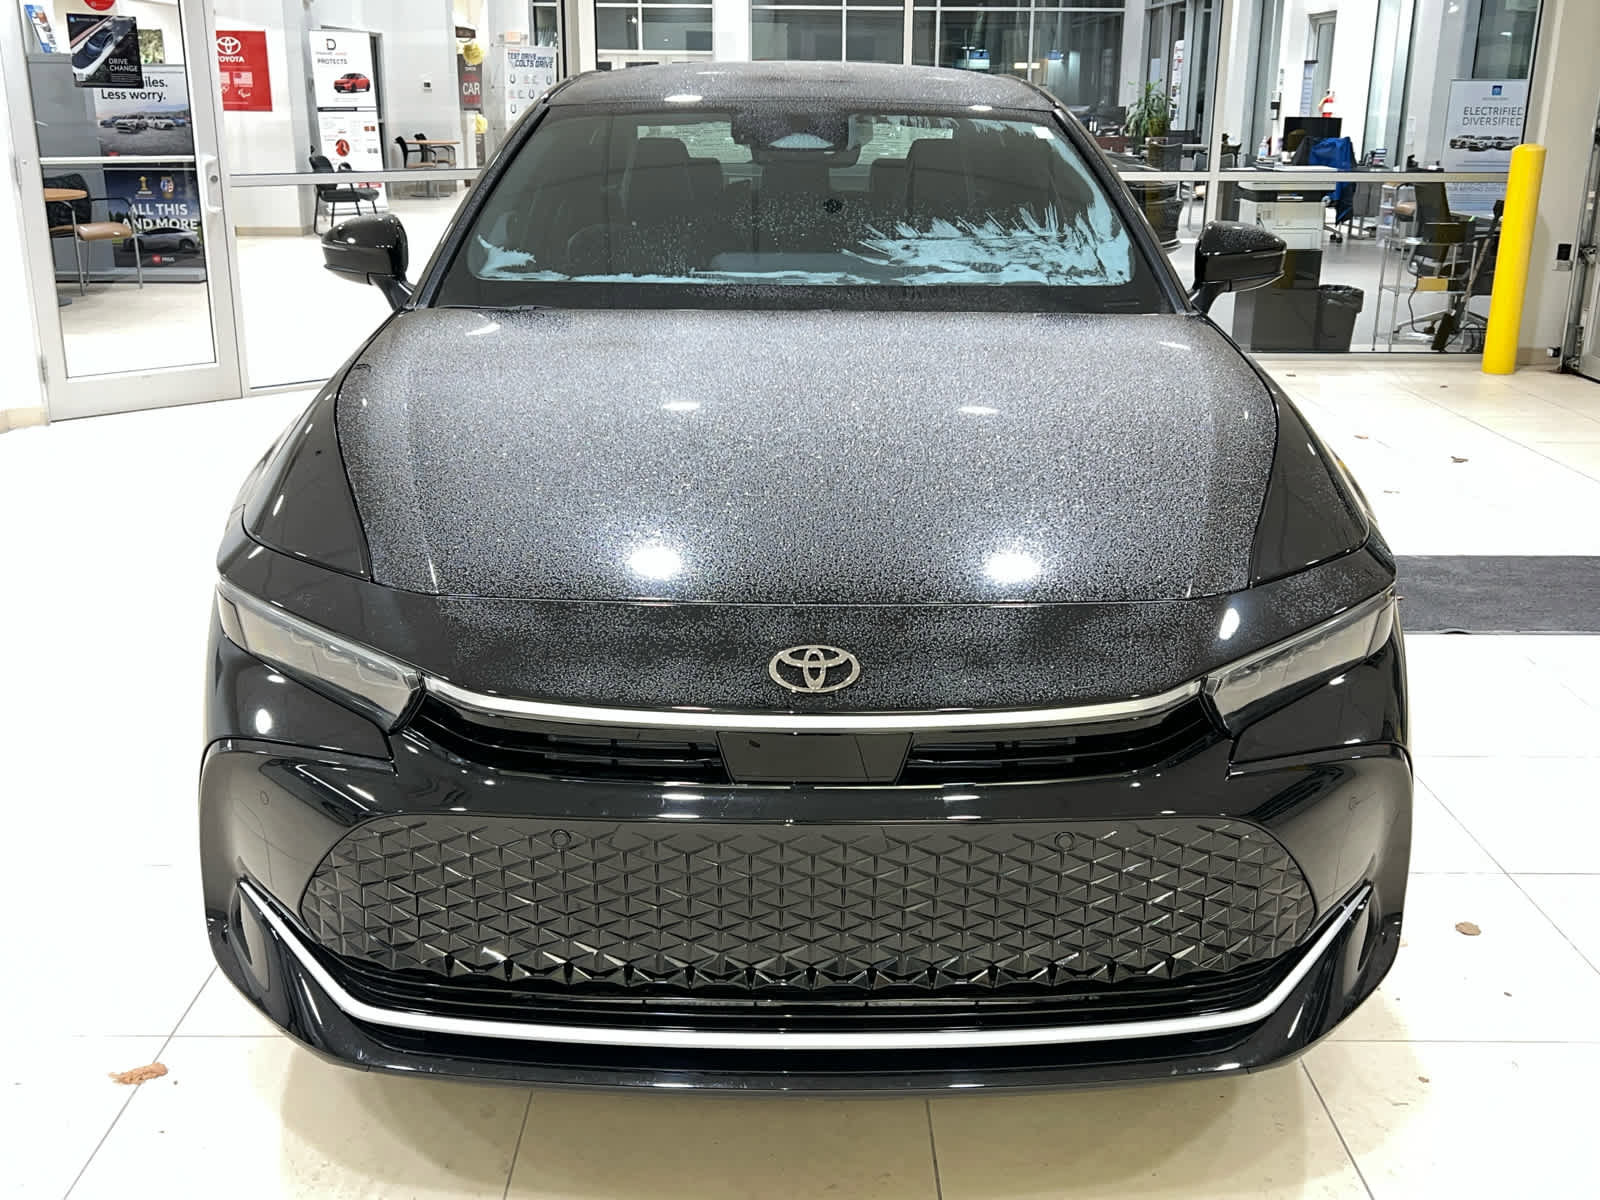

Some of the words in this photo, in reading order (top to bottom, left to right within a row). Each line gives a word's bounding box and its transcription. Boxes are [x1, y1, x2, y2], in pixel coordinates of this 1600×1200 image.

[144, 76, 168, 88] iles.
[462, 82, 481, 96] CAR
[101, 88, 127, 100] Less
[129, 91, 167, 103] worry.
[128, 203, 154, 215] ALL
[155, 203, 188, 215] THIS
[122, 218, 154, 230] AND
[156, 218, 198, 230] MORE
